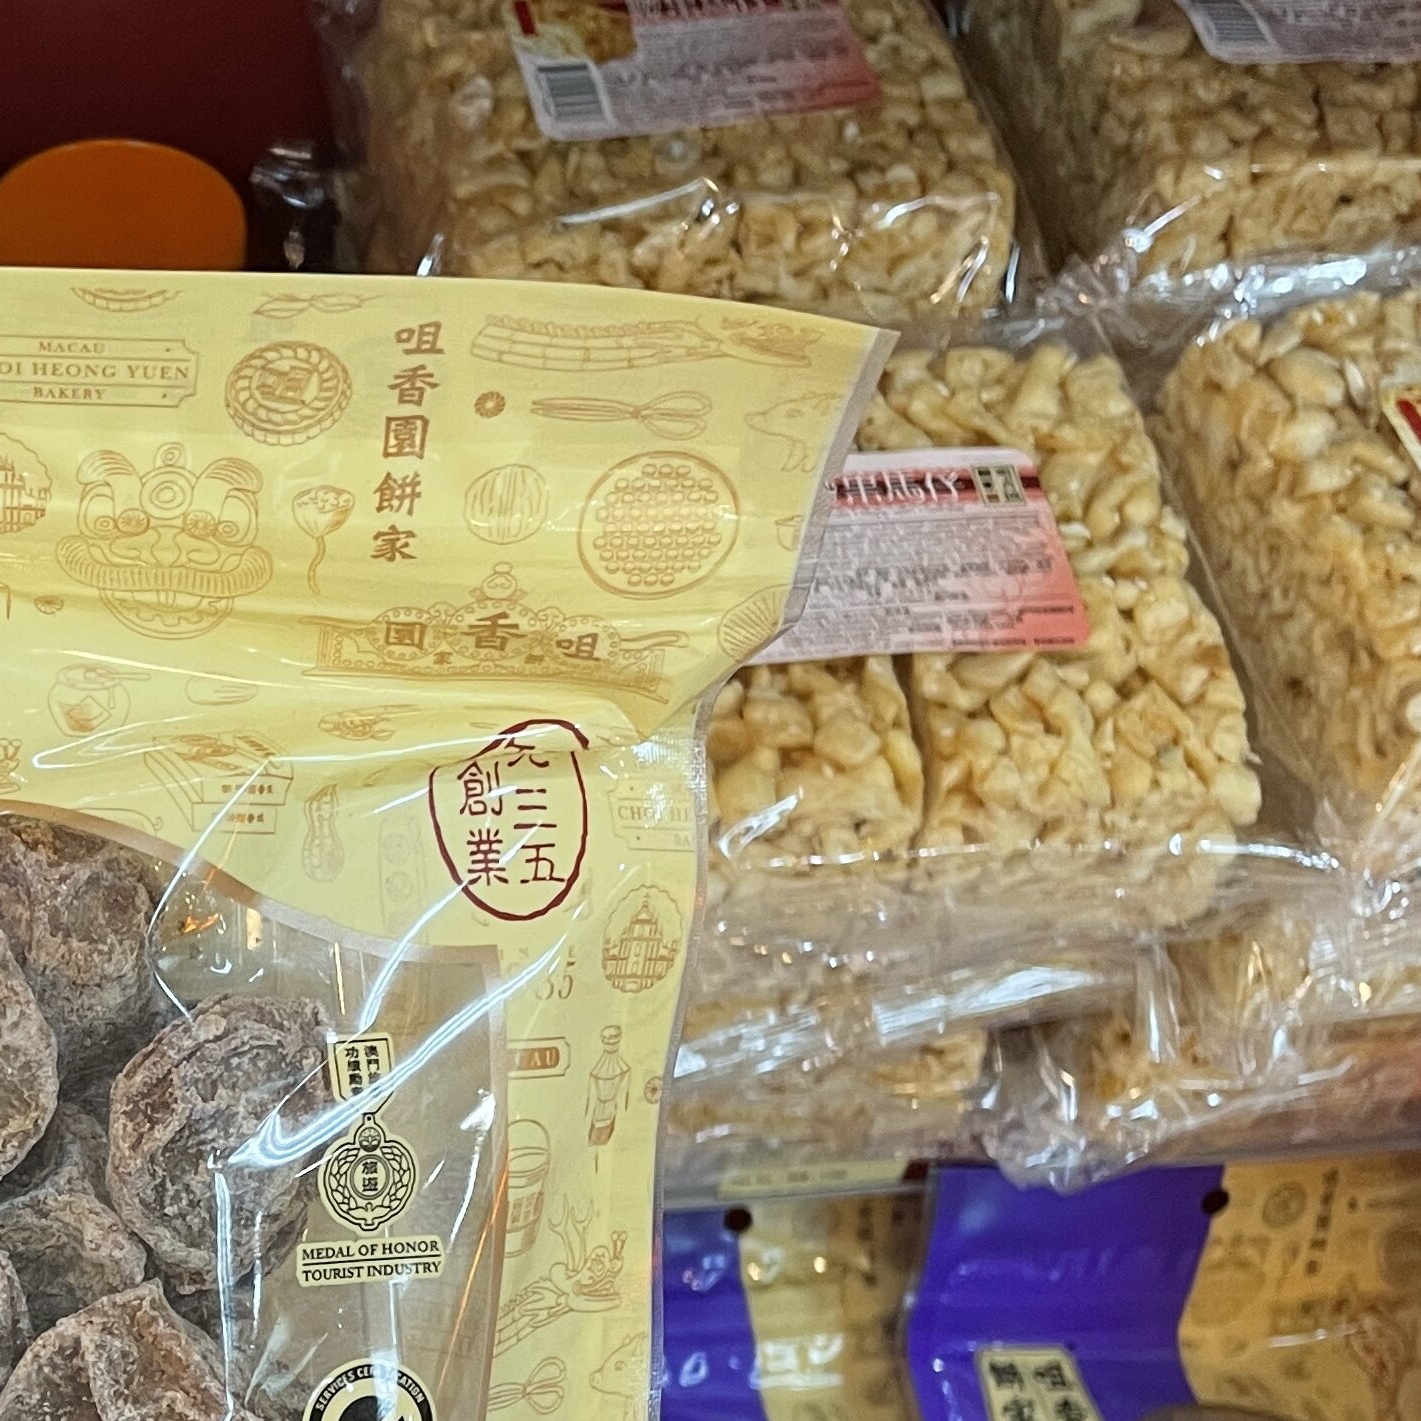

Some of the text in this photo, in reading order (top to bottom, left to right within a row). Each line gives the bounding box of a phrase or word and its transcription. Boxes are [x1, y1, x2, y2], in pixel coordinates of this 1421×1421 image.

[37, 341, 105, 354] MACAU
[32, 362, 116, 379] HEONG
[127, 364, 190, 380] YUEN
[32, 386, 107, 401] BAKERY
[369, 320, 445, 562] 咀香園餅家
[457, 761, 510, 886] 創業
[302, 1240, 440, 1261] MEDAL OF HONOR
[302, 1261, 442, 1282] TOURIST INDUSTRY
[315, 1371, 356, 1412] SERVICES
